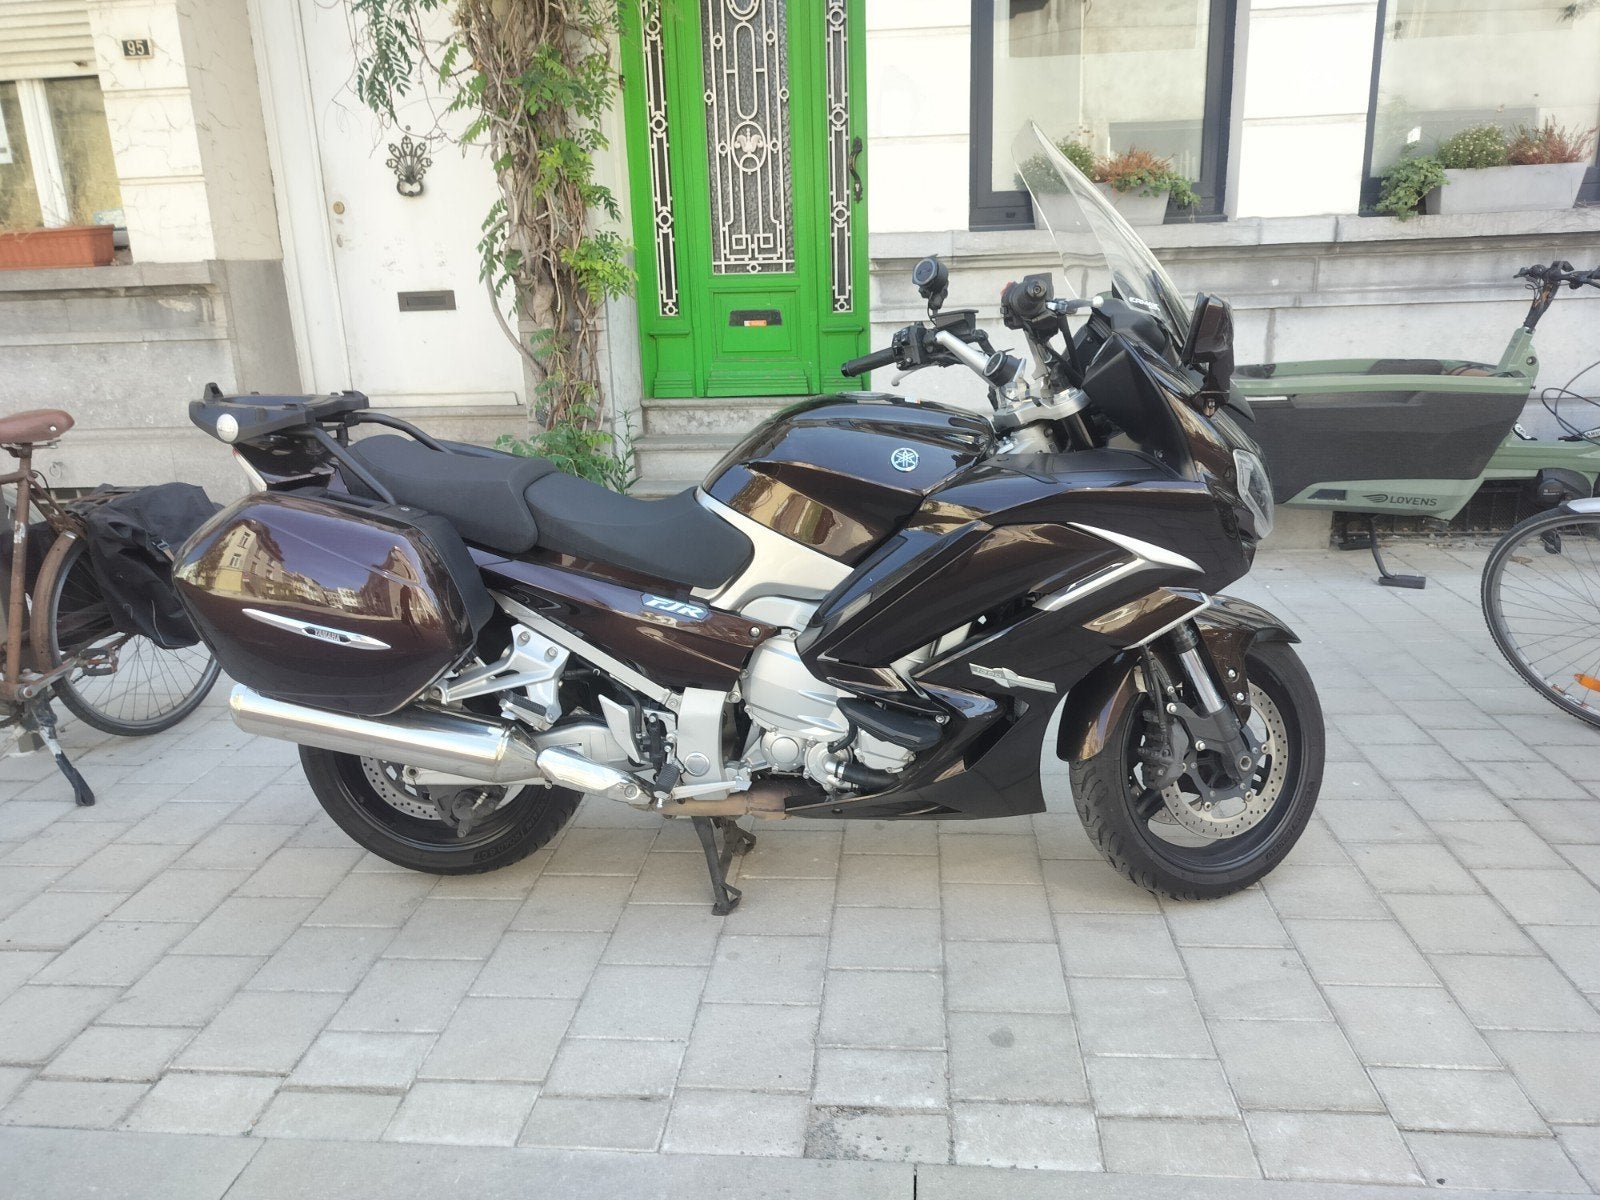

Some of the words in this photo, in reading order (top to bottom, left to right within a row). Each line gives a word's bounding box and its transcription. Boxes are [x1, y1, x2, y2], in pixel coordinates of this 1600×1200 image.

[126, 40, 145, 56] 95
[1389, 495, 1438, 507] LOVENS
[645, 595, 704, 619] FJR
[314, 628, 341, 642] YAMAHA
